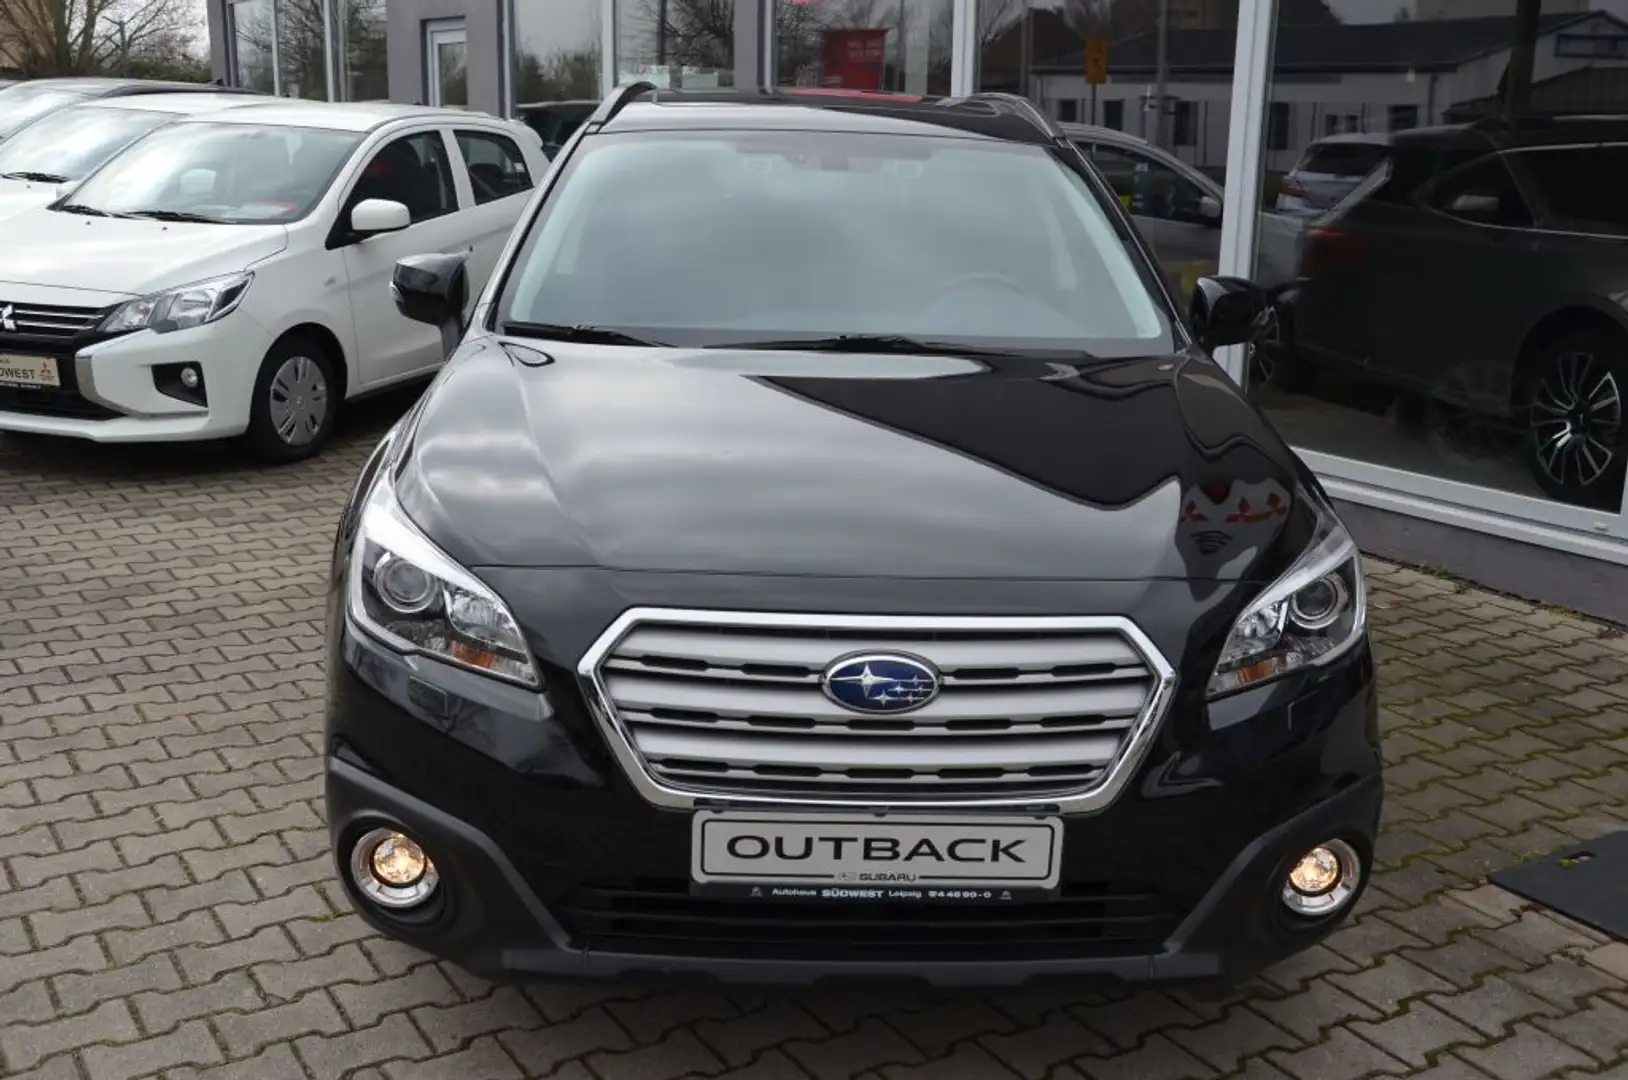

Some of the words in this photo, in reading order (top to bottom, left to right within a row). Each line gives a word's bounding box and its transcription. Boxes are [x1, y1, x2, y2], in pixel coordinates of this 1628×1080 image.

[726, 835, 1027, 863] OUTBACK
[859, 872, 917, 882] SUBARU
[771, 887, 817, 897] Autohaus
[821, 887, 884, 898] SÜDWEST
[888, 889, 922, 899] Leipzig
